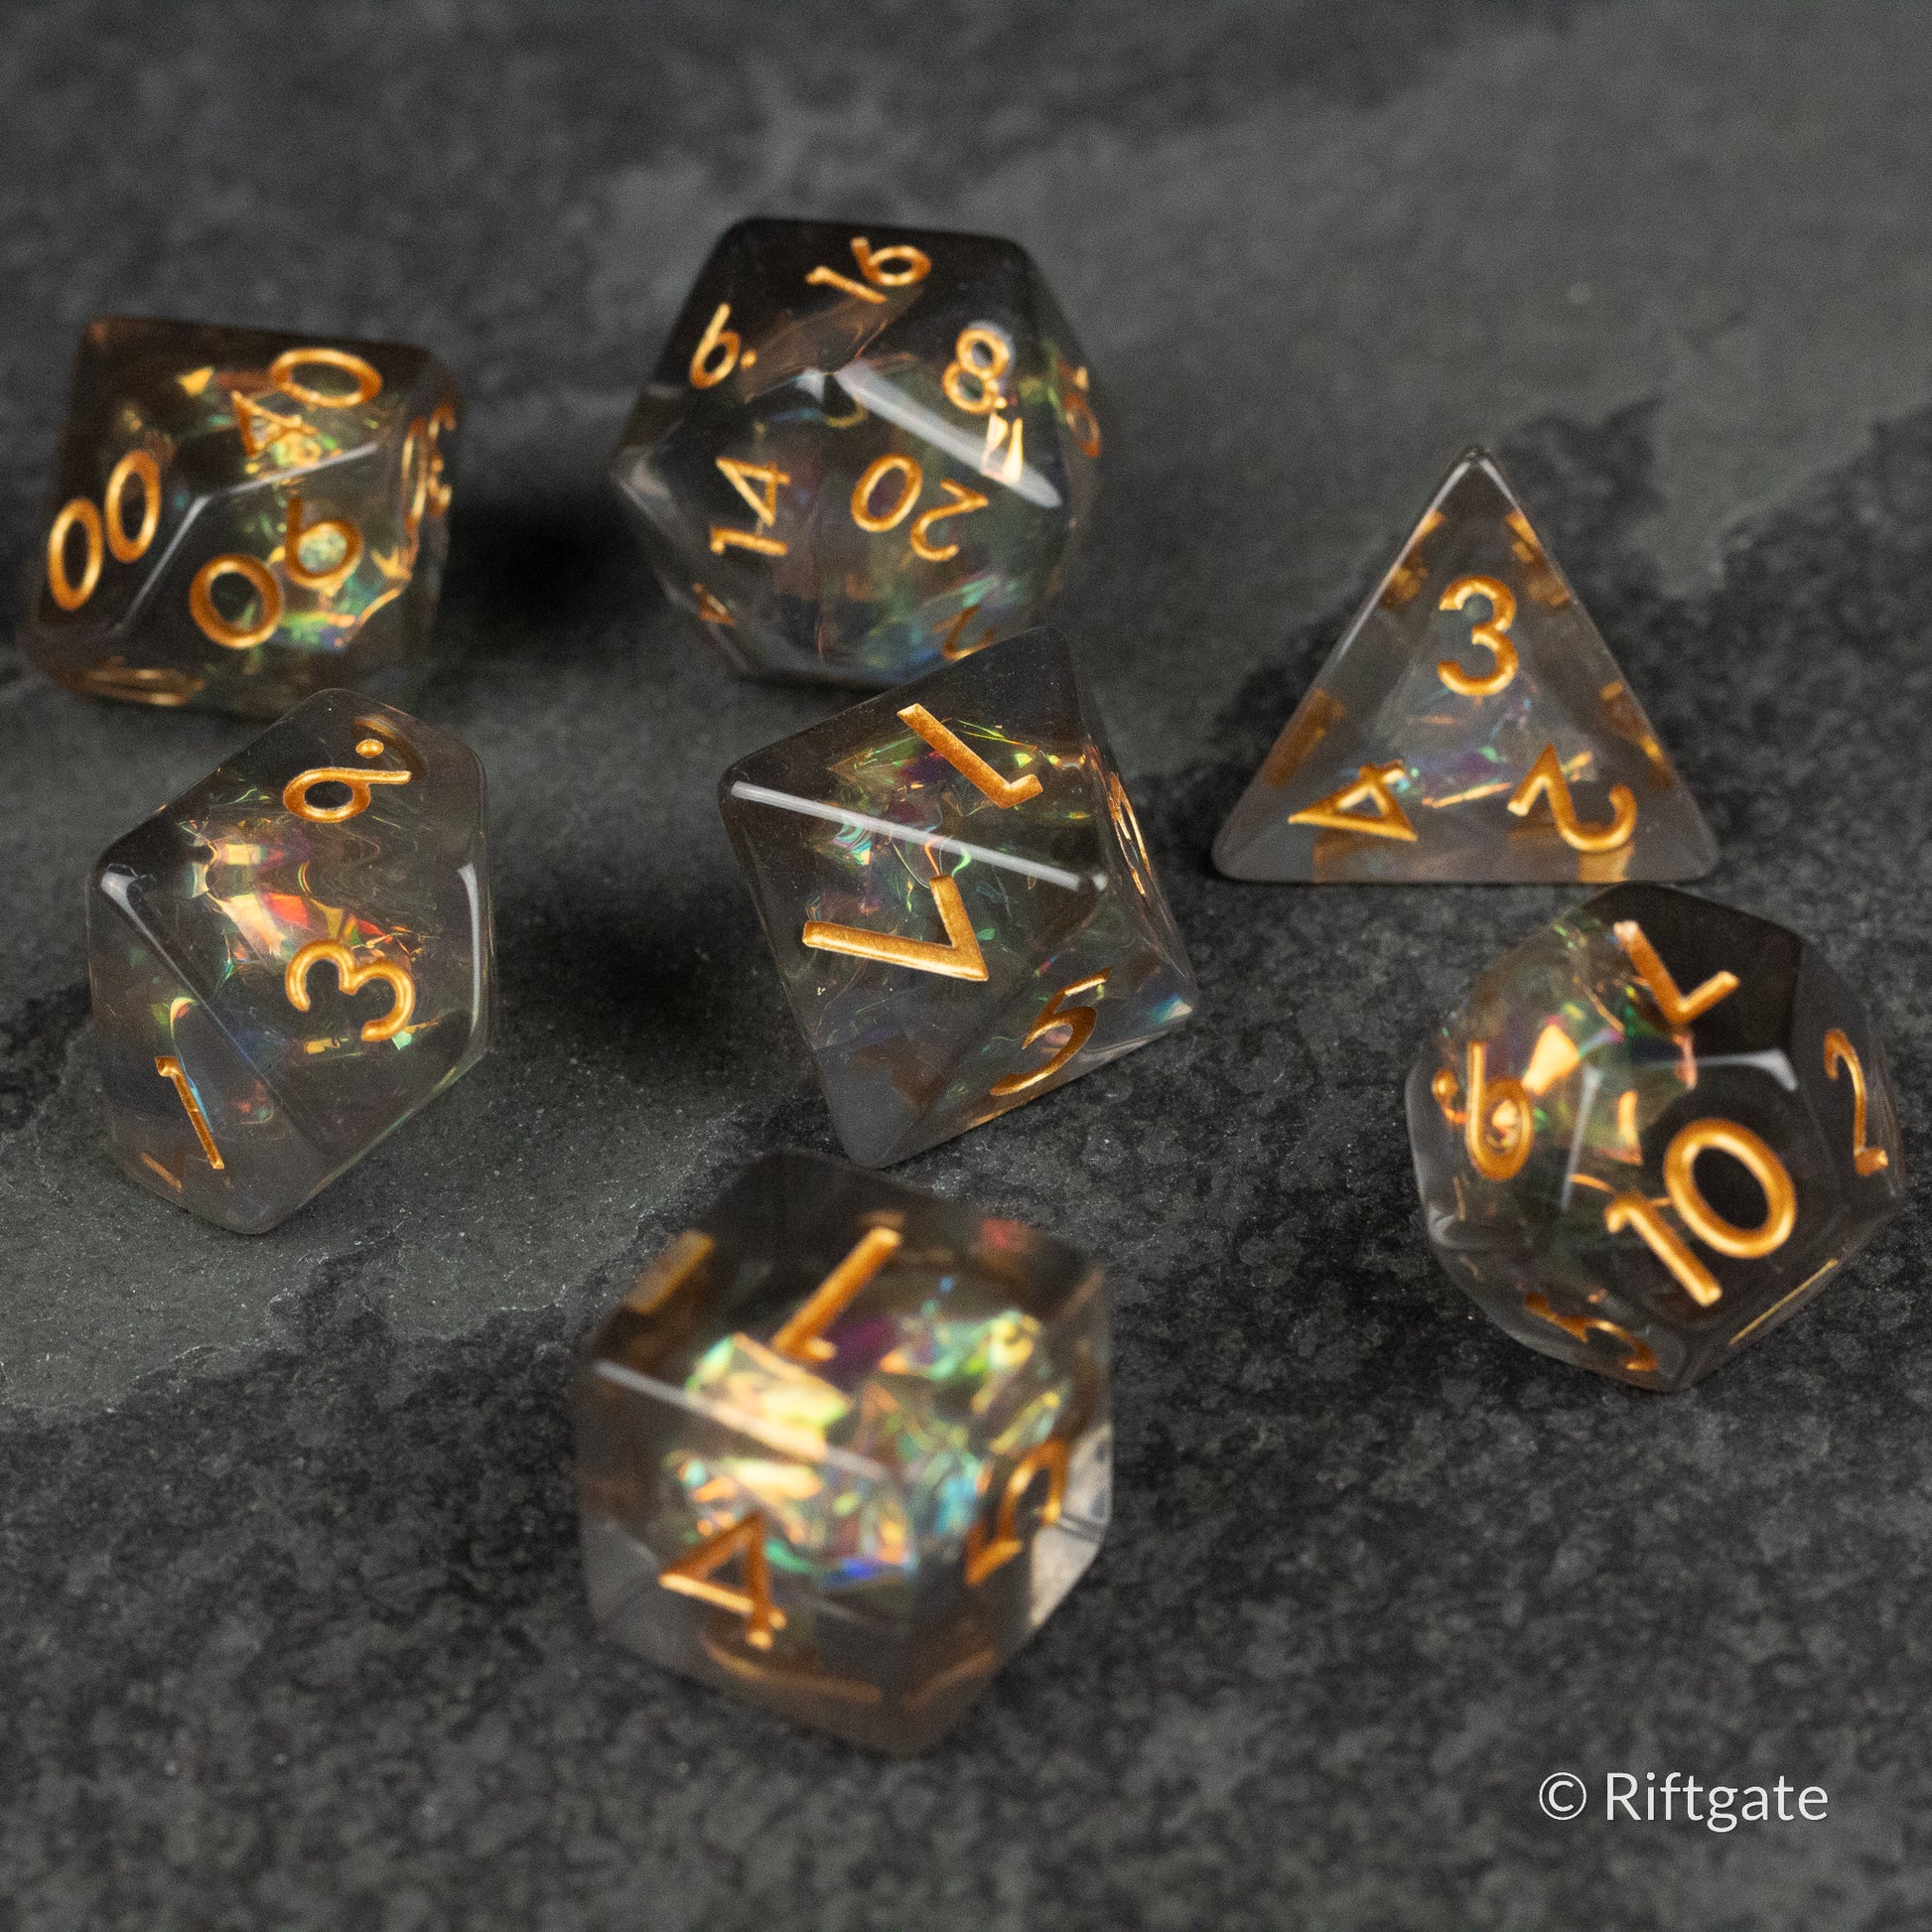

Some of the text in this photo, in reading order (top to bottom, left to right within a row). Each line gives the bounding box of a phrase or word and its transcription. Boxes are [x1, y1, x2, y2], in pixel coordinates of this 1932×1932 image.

[805, 236, 932, 303] 16
[47, 450, 162, 612] 00
[709, 456, 791, 557] 14
[1437, 575, 1519, 697] 3
[1288, 758, 1418, 843] 4
[1507, 743, 1638, 852] 2
[802, 874, 989, 982] 7
[1612, 920, 1741, 1025] 7
[285, 939, 415, 1042] 3
[989, 967, 1113, 1096] 5
[154, 1055, 224, 1170] 1
[1824, 1028, 1888, 1177] 2
[1603, 1116, 1797, 1308] 10
[770, 1227, 901, 1363] 1
[659, 1511, 786, 1652] 4
